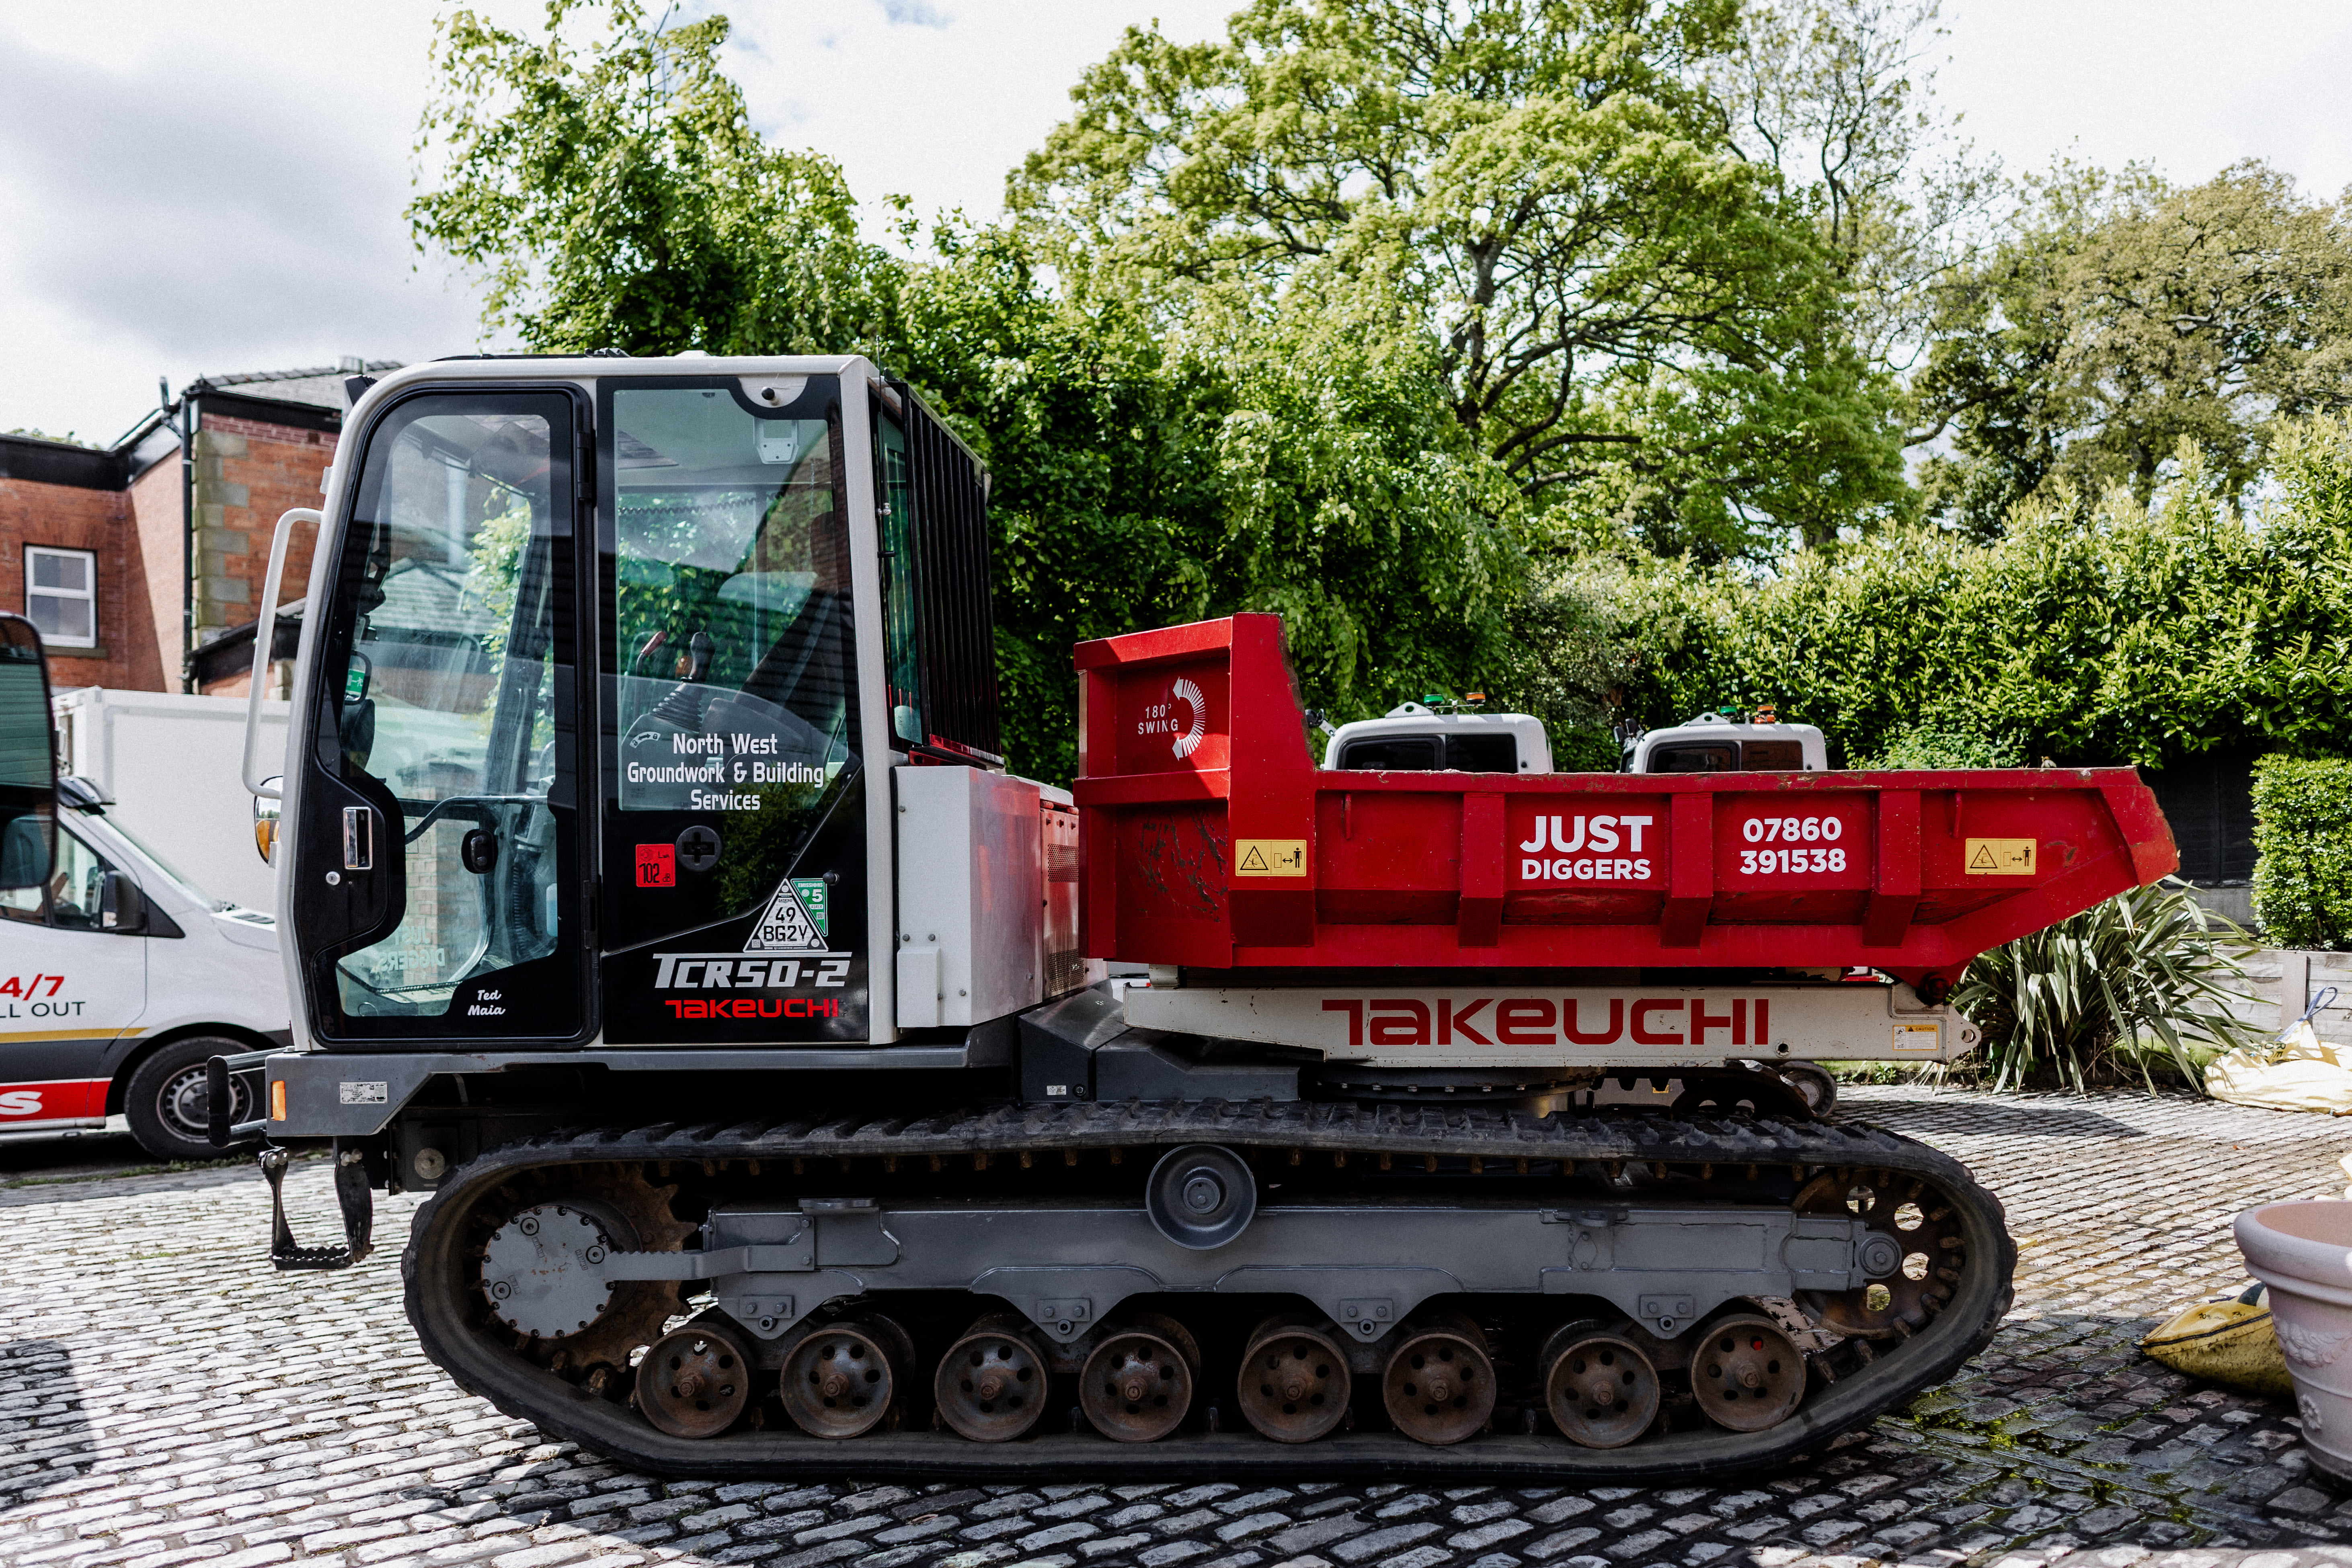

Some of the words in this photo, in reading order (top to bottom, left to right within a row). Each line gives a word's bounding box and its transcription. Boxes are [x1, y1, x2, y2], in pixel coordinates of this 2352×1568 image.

[1138, 718, 1178, 735] SWING
[673, 733, 723, 754] North
[731, 733, 778, 754] West
[628, 762, 725, 783] Groundwork
[734, 762, 747, 783] &
[753, 762, 823, 788] Building
[691, 789, 760, 810] Services
[1519, 815, 1652, 853] JUST
[1743, 817, 1842, 842] 07860
[1522, 859, 1651, 880] DIGGERS
[1739, 848, 1846, 874] 391538
[639, 863, 660, 883] 102
[662, 873, 671, 882] dB
[812, 889, 823, 902] 5
[776, 907, 796, 923] 49
[763, 925, 808, 942] BG2Y
[653, 952, 852, 988] TCR50-2
[0, 974, 64, 1001] 4/7
[478, 989, 502, 1001] Ted
[31, 1002, 86, 1017] OUT
[468, 1005, 506, 1016] Maia
[0, 1091, 43, 1115] S
